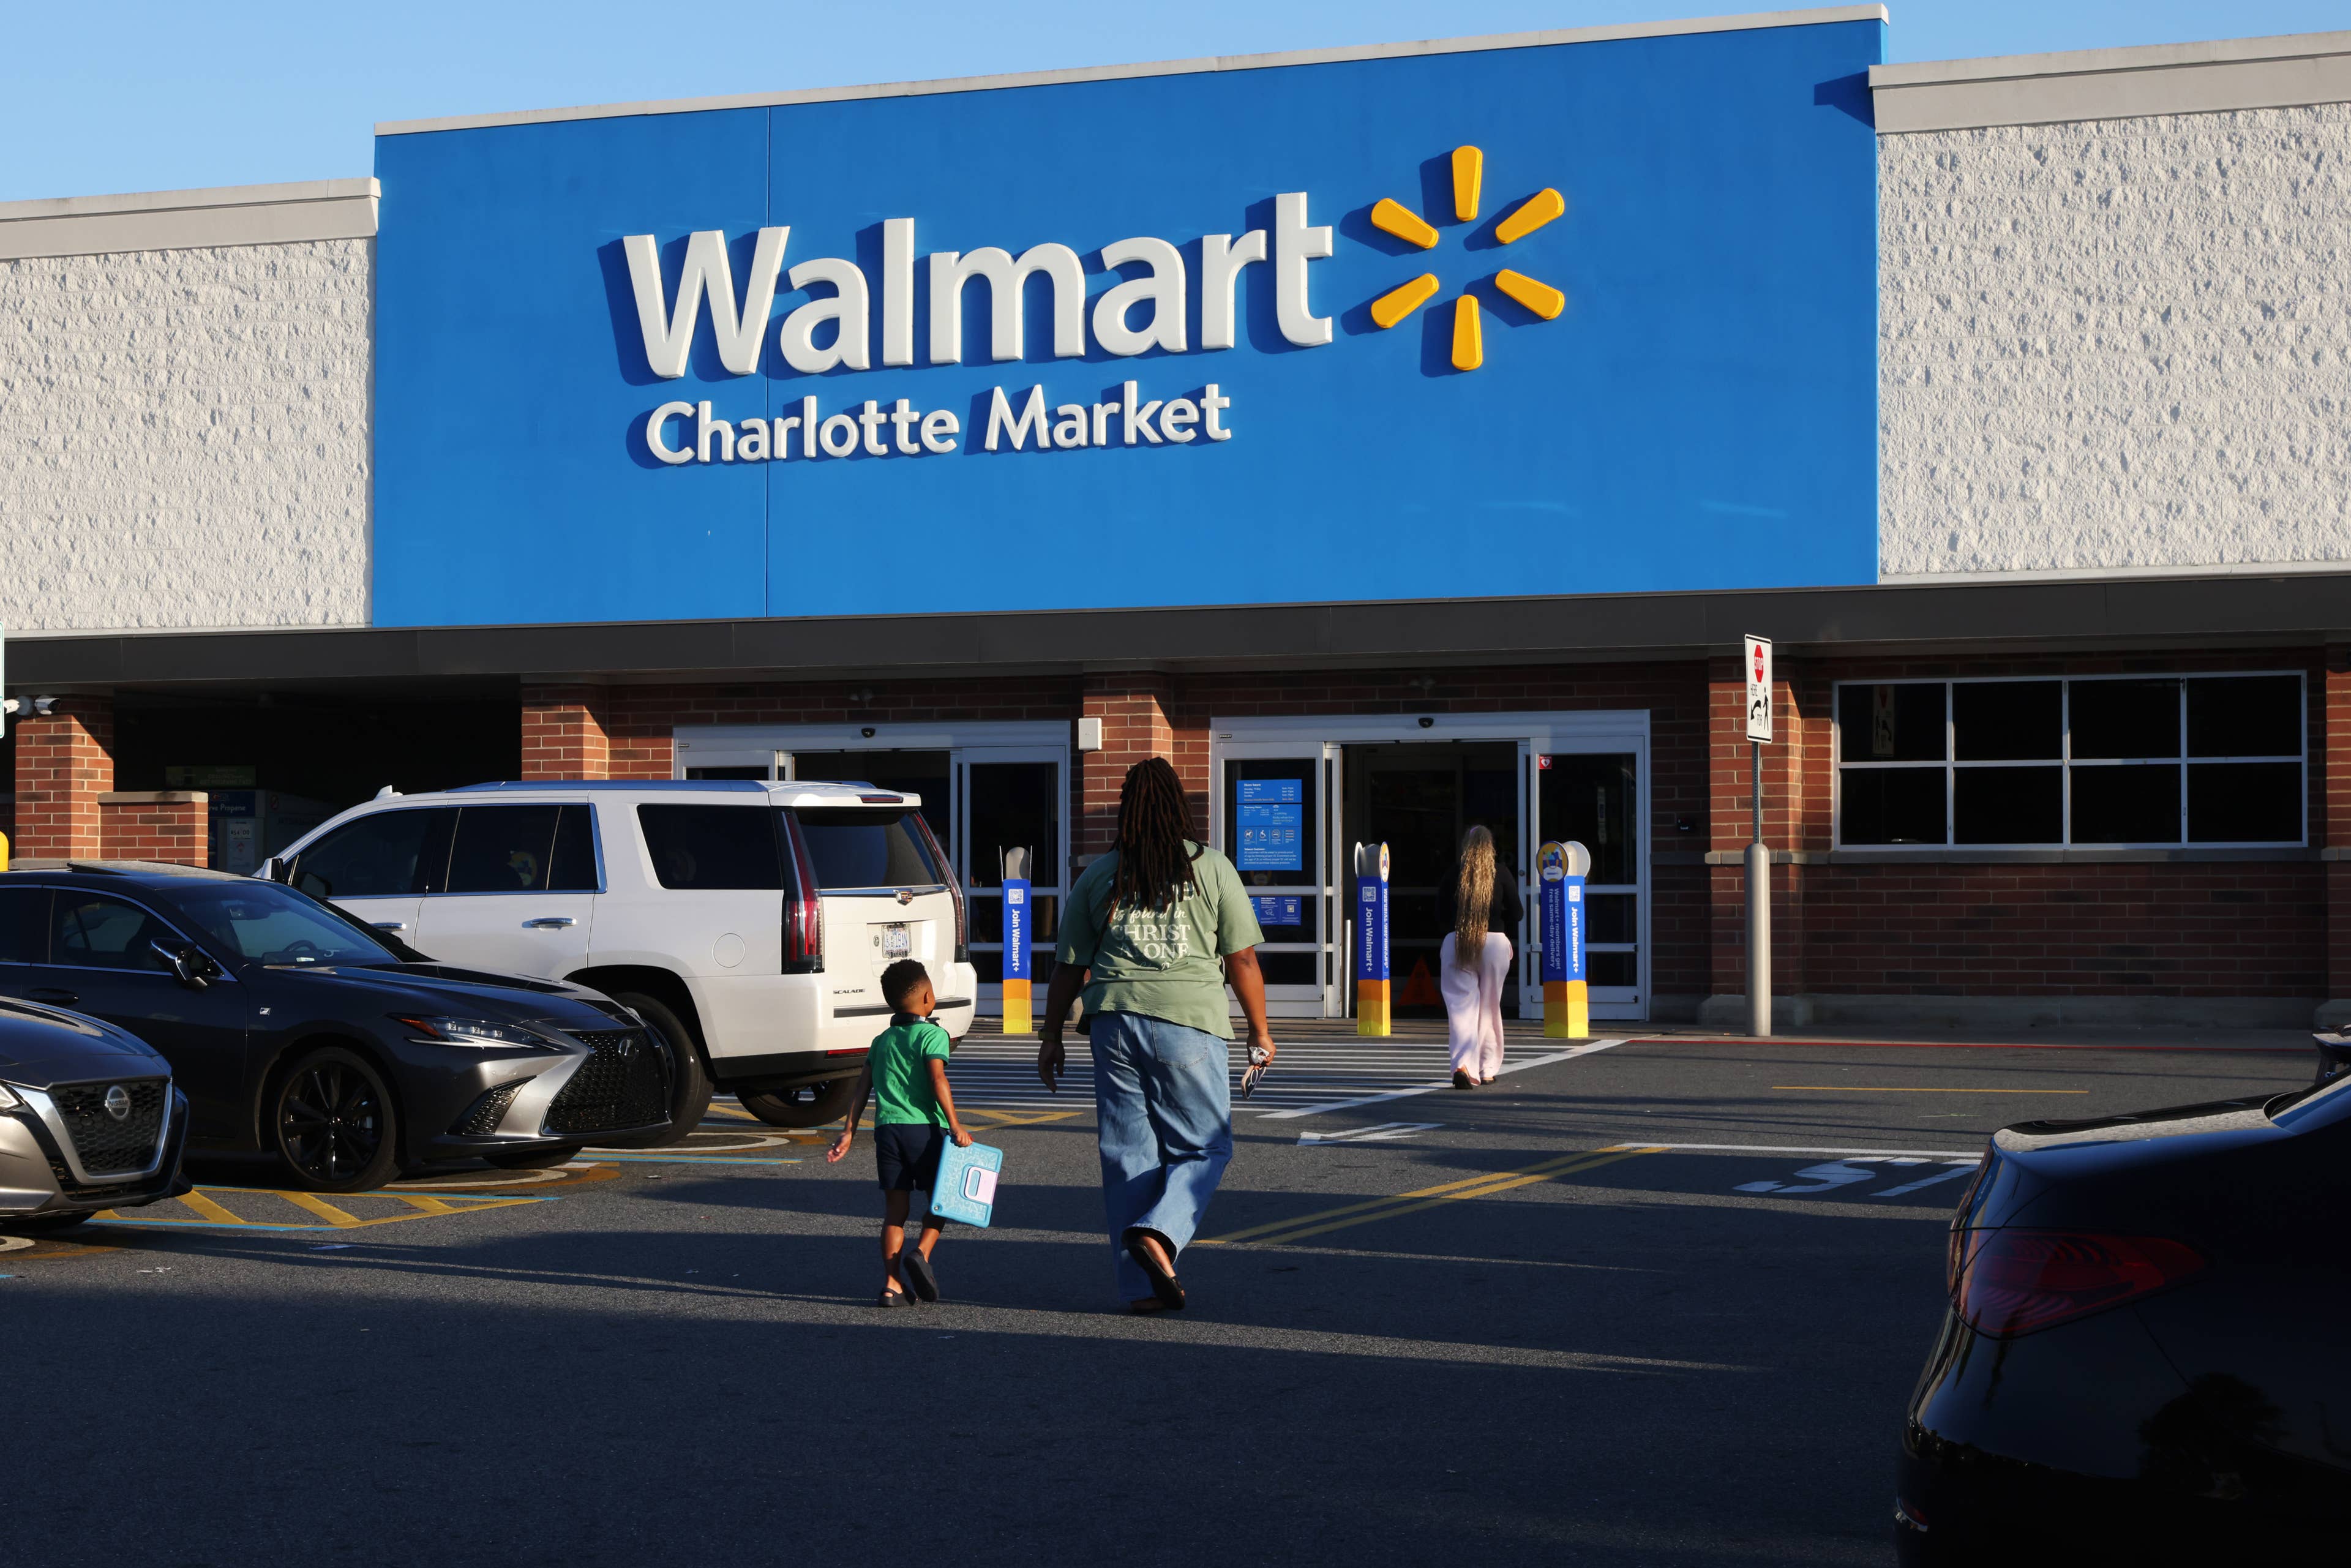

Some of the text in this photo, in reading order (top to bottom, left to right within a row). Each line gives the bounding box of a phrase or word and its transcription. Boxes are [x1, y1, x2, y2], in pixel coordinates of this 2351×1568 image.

[623, 192, 1333, 378] Walmart
[646, 380, 1231, 464] Charlotte Market
[1755, 656, 1763, 671] STOP
[1174, 907, 1187, 918] in
[1111, 924, 1191, 941] CHRIST
